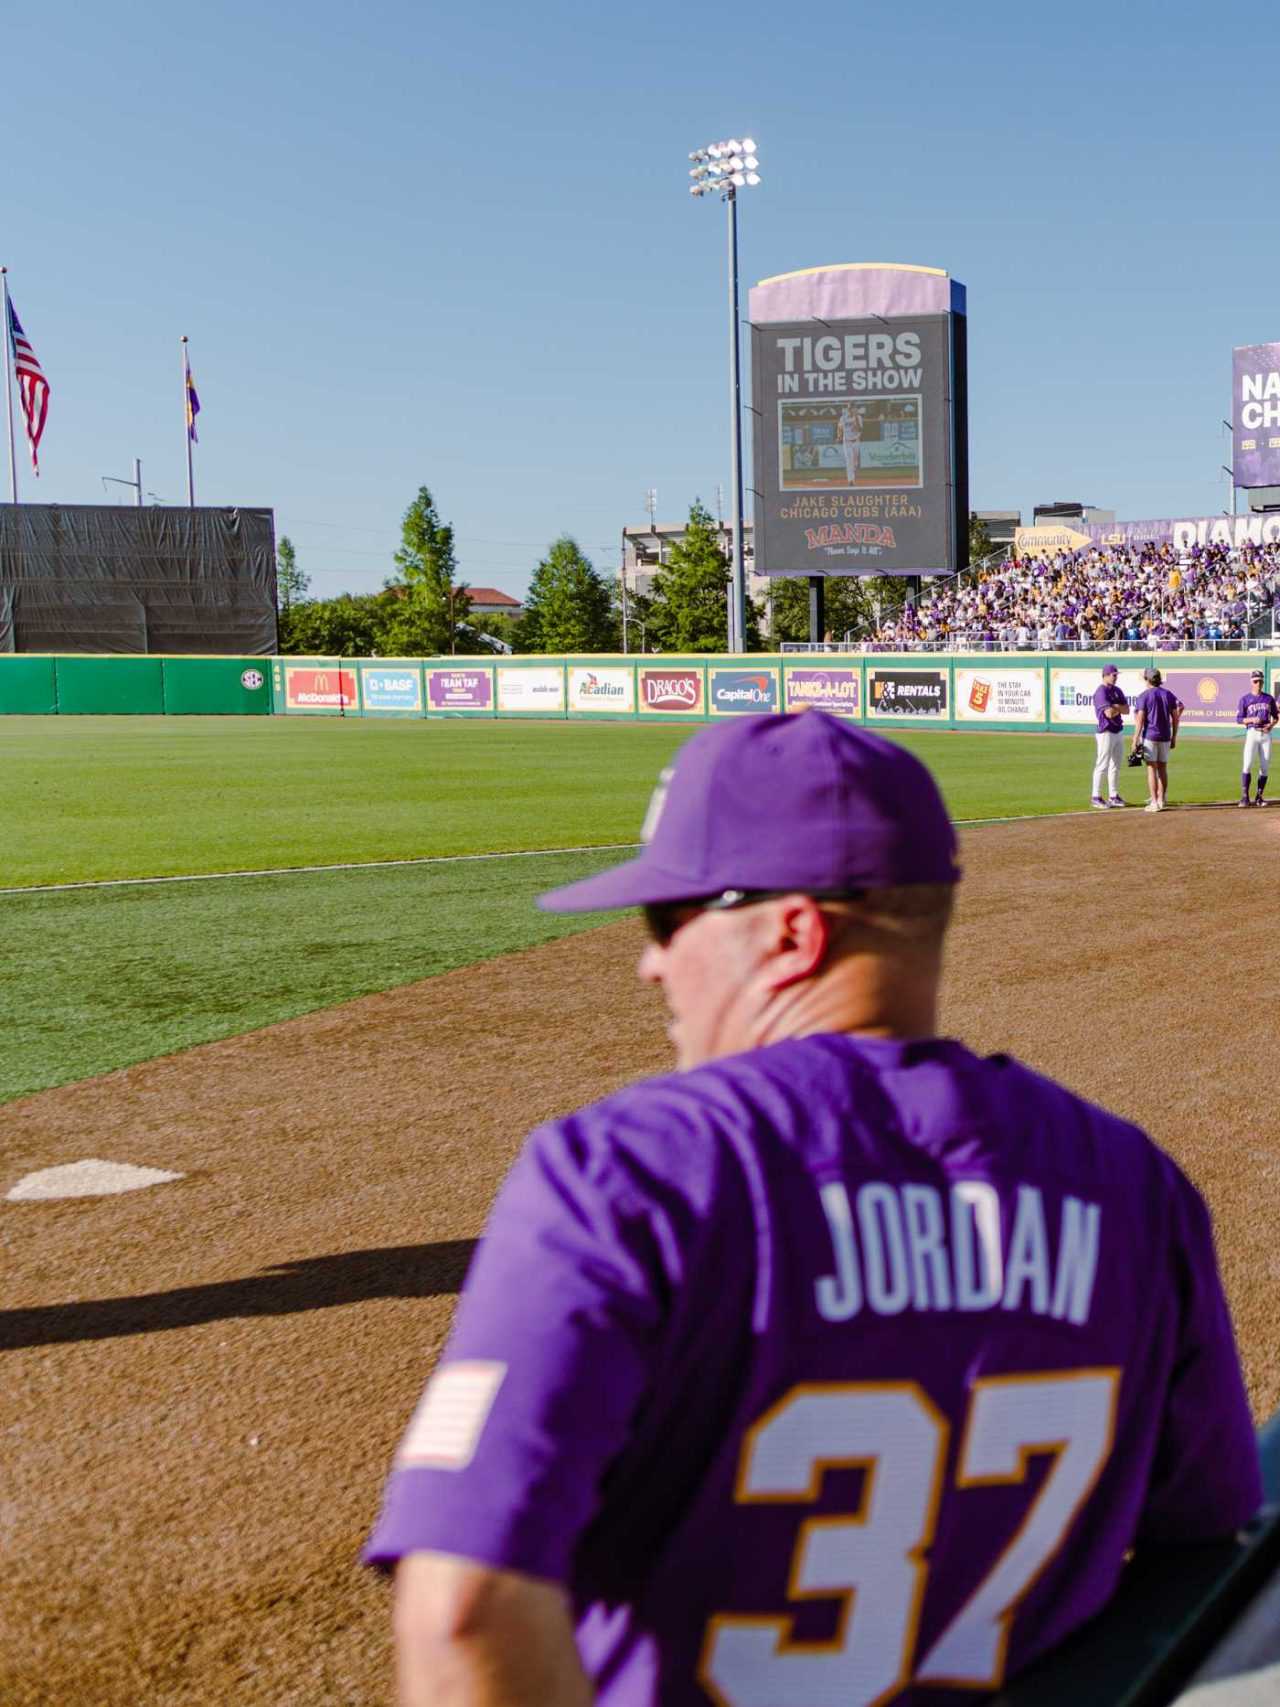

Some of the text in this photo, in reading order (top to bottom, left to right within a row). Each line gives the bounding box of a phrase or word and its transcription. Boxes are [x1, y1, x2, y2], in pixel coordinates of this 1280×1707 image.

[776, 332, 921, 372] TIGERS
[777, 368, 923, 393] IN THE SHOW
[780, 505, 921, 519] CHICAGO CUBS (AAA)
[793, 495, 908, 507] JAKE SLAUGHTER
[804, 523, 897, 550] MANDA
[1102, 534, 1126, 544] LSU
[580, 682, 624, 695] Acadian
[647, 678, 696, 704] DRAGO'S
[897, 685, 941, 697] RENTALS
[815, 1181, 1101, 1327] JORDAN
[697, 1367, 1123, 1707] 37
